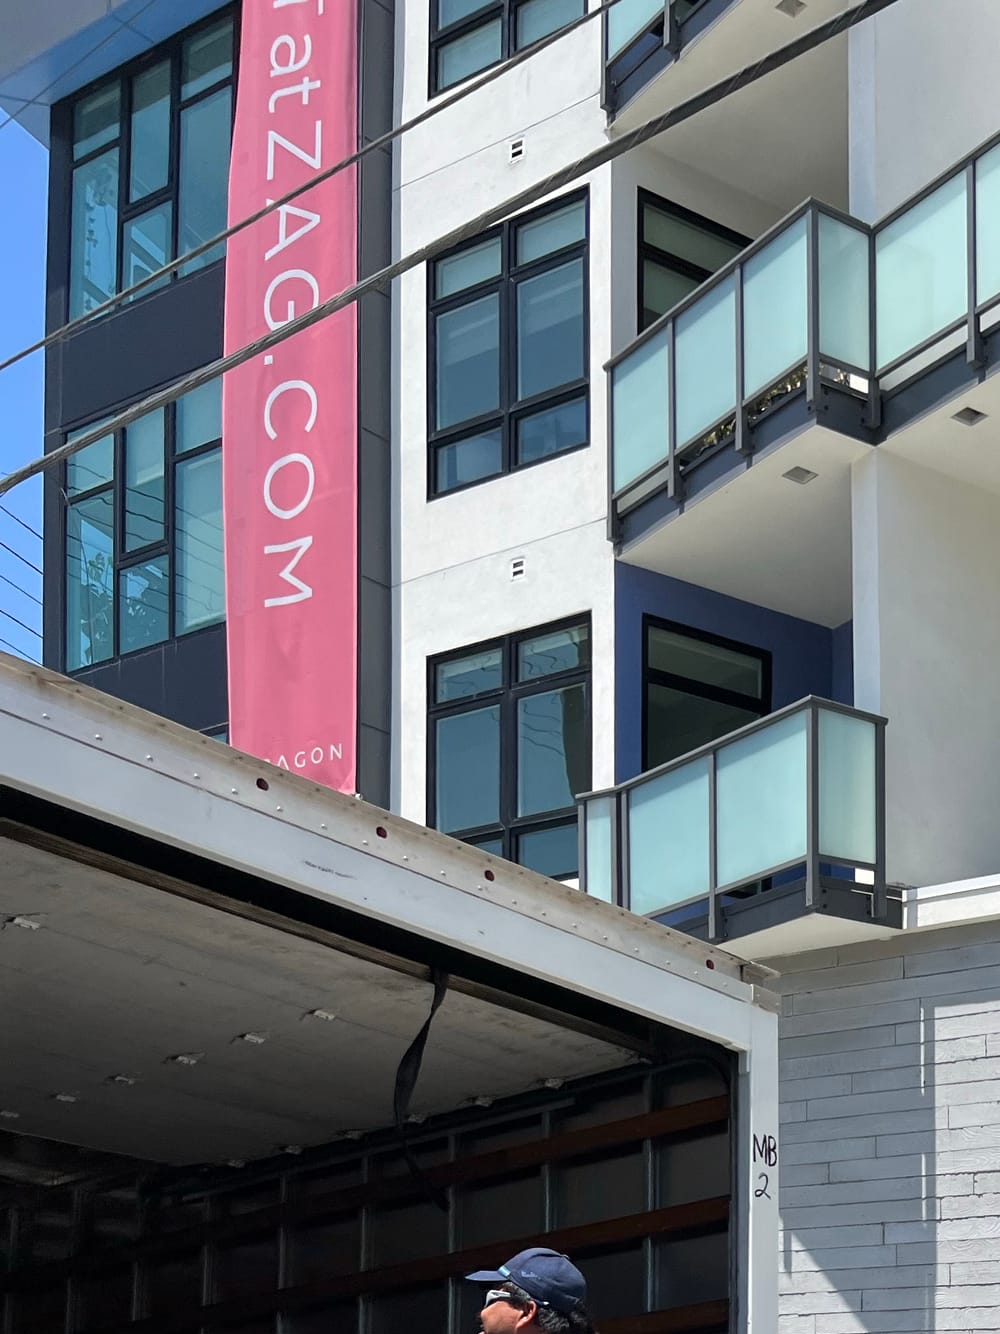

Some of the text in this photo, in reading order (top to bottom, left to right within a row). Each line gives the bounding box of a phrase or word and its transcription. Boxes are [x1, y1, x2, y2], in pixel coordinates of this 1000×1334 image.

[264, 743, 342, 771] AGON
[752, 1133, 778, 1167] MB
[754, 1172, 771, 1200] 2
